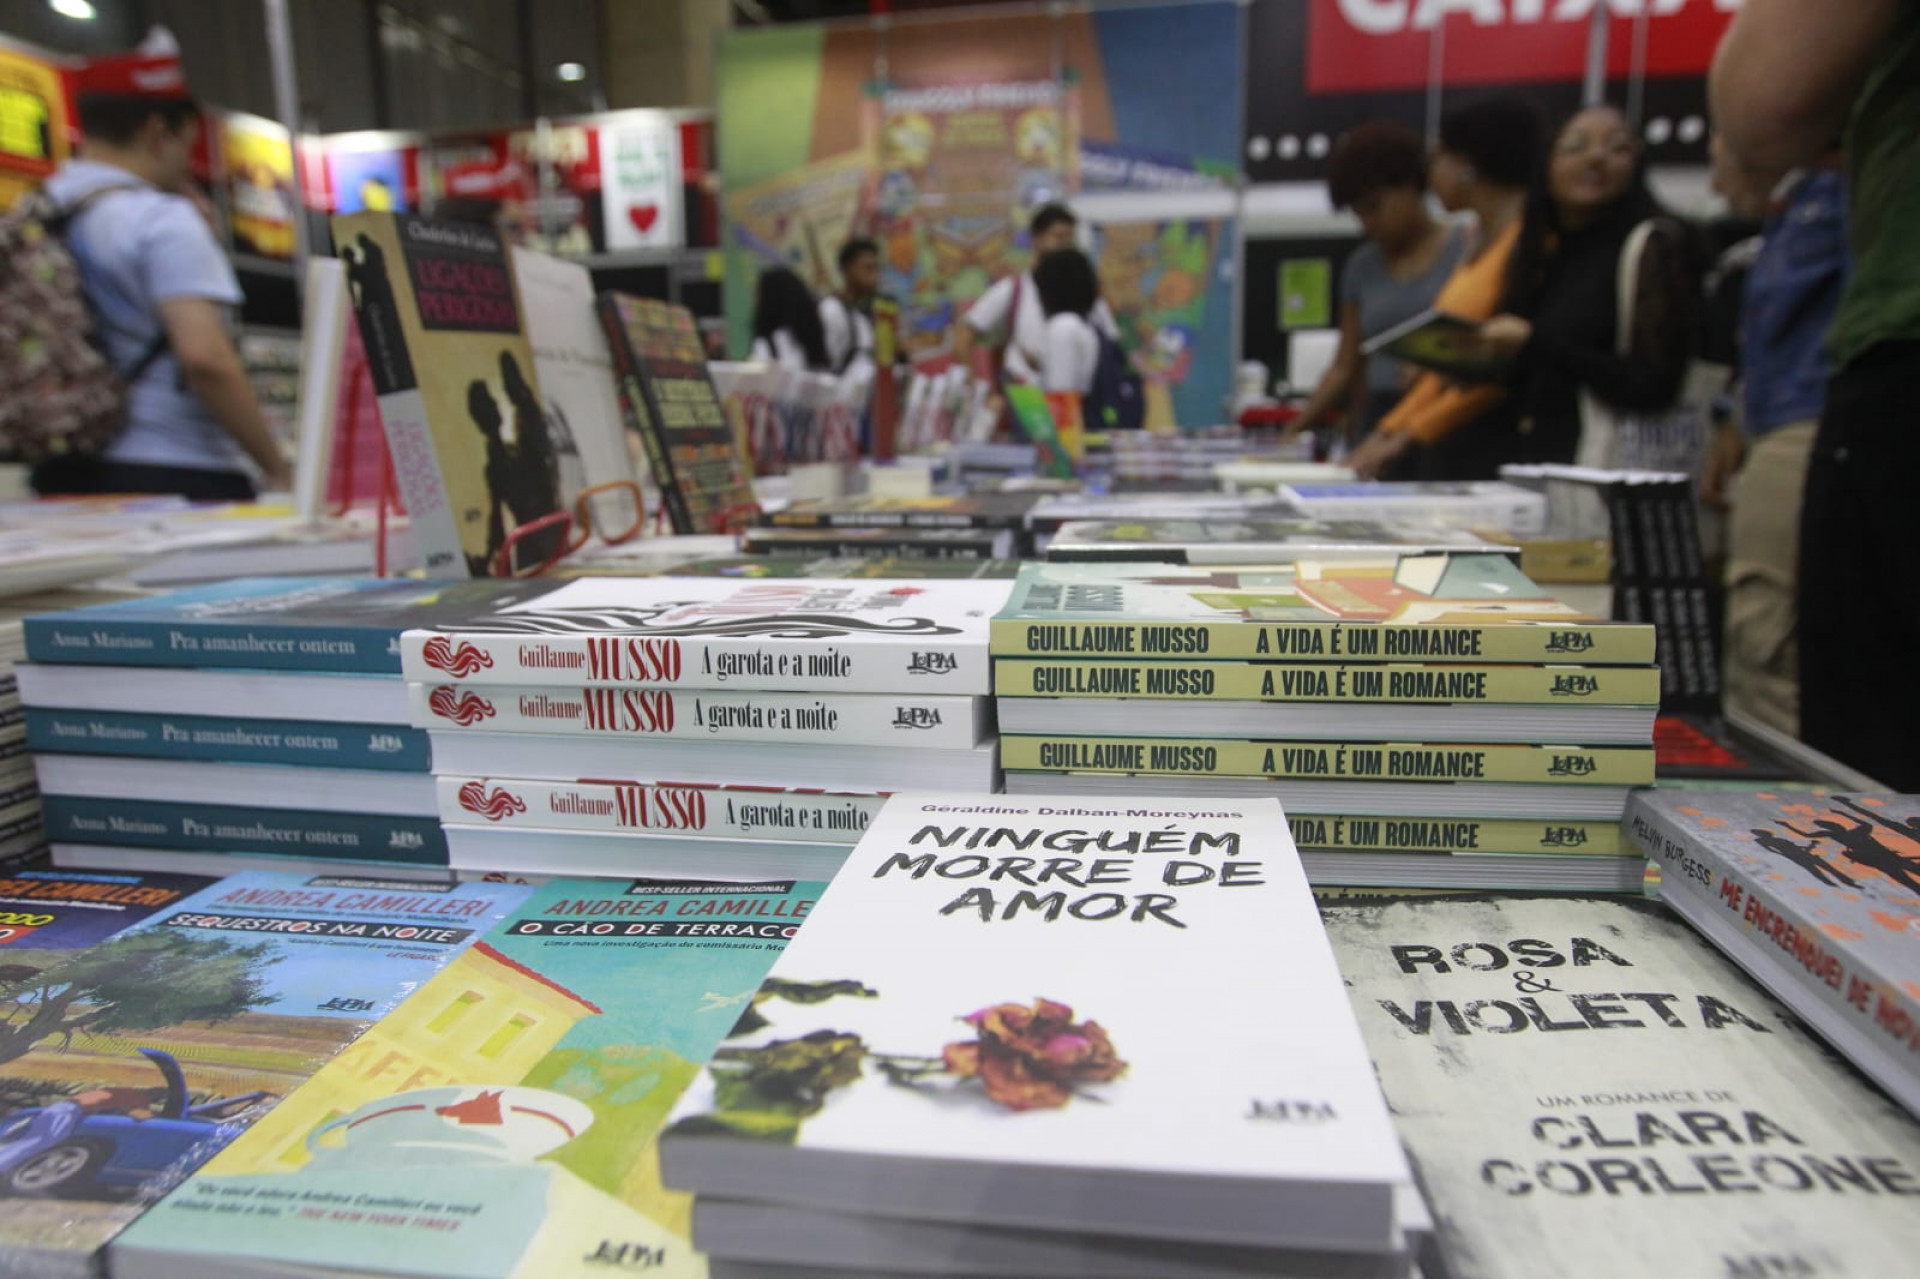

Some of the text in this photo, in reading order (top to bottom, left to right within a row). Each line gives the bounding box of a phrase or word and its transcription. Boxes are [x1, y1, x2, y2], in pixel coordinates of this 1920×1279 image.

[52, 631, 356, 654] Anna Mariano Pra amanhecer ontem
[1027, 626, 1138, 652] GUILLAUME
[1141, 628, 1210, 653] MUSSO
[1257, 629, 1271, 653] A
[1274, 629, 1328, 654] VIDA
[1331, 623, 1342, 654] É
[1347, 630, 1378, 654] UM
[1384, 630, 1482, 655] ROMANCE
[518, 643, 586, 670] Guillaume
[586, 637, 681, 682] MUSSO
[701, 646, 714, 674] A
[716, 648, 775, 679] garota
[777, 654, 789, 678] e
[791, 654, 804, 678] a
[808, 648, 852, 678] noite
[1033, 668, 1141, 694] GUILLAUME
[1145, 670, 1215, 695] MUSSO
[1261, 671, 1275, 696] A
[1278, 671, 1328, 696] VIDA
[1333, 664, 1345, 697] É
[1350, 671, 1383, 697] UM
[1388, 672, 1487, 698] ROMANCE
[518, 695, 583, 721] Guillaume
[583, 689, 675, 732] MUSSO
[694, 698, 706, 726] A
[708, 700, 764, 731] garota
[767, 706, 778, 728] e
[780, 707, 792, 729] a
[795, 700, 838, 730] noite
[51, 721, 87, 737] Anna
[90, 723, 147, 739] Mariano
[162, 724, 190, 742] Pra
[194, 726, 281, 747] amanhecer
[286, 733, 339, 749] ontem
[1040, 743, 1146, 770] GUILLAUME
[1150, 745, 1217, 772] MUSSO
[1262, 747, 1276, 773] A
[1280, 748, 1330, 774] VIDA
[1335, 742, 1347, 775] É
[1352, 749, 1384, 775] UM
[1388, 751, 1485, 777] ROMANCE
[550, 786, 868, 831] Guillaume MUSSO A garota e a noite
[921, 804, 1244, 819] Géraldine Dalban-Moreynas
[70, 815, 106, 830] Anna
[108, 816, 167, 833] Mariano
[182, 818, 211, 836] Pra
[215, 820, 302, 842] amanhecer
[306, 827, 359, 845] ontem
[909, 823, 1241, 856] NINGUÉM
[1334, 813, 1345, 846] É
[1350, 821, 1381, 847] UM
[1384, 823, 1479, 848] ROMANCE
[872, 853, 1266, 889] MORRE DE
[216, 888, 495, 917] ANDREA CAMILLERI
[631, 885, 700, 894] BEST-SELLER
[1632, 815, 1664, 851] MELVIN
[1665, 840, 1712, 887] BURGESS
[1719, 876, 1744, 912] ME
[1743, 895, 1846, 992] ENCRENQUEI
[543, 899, 816, 918] ANDREA CAMILLE
[939, 887, 1188, 929] AMOR
[168, 914, 456, 942] SEQUESTROS NA NOITE
[519, 920, 799, 938] O CÃO DE TERRACO
[601, 939, 677, 949] investigação
[695, 941, 763, 950] comissário
[1391, 937, 1634, 974] ROSA
[1512, 970, 1564, 993] &
[1376, 992, 1774, 1036] VIOLETA
[1536, 1089, 1738, 1109] UM ROMANCE DE
[1532, 1110, 1805, 1150] CLARA
[1481, 1155, 1920, 1197] CORLEONE
